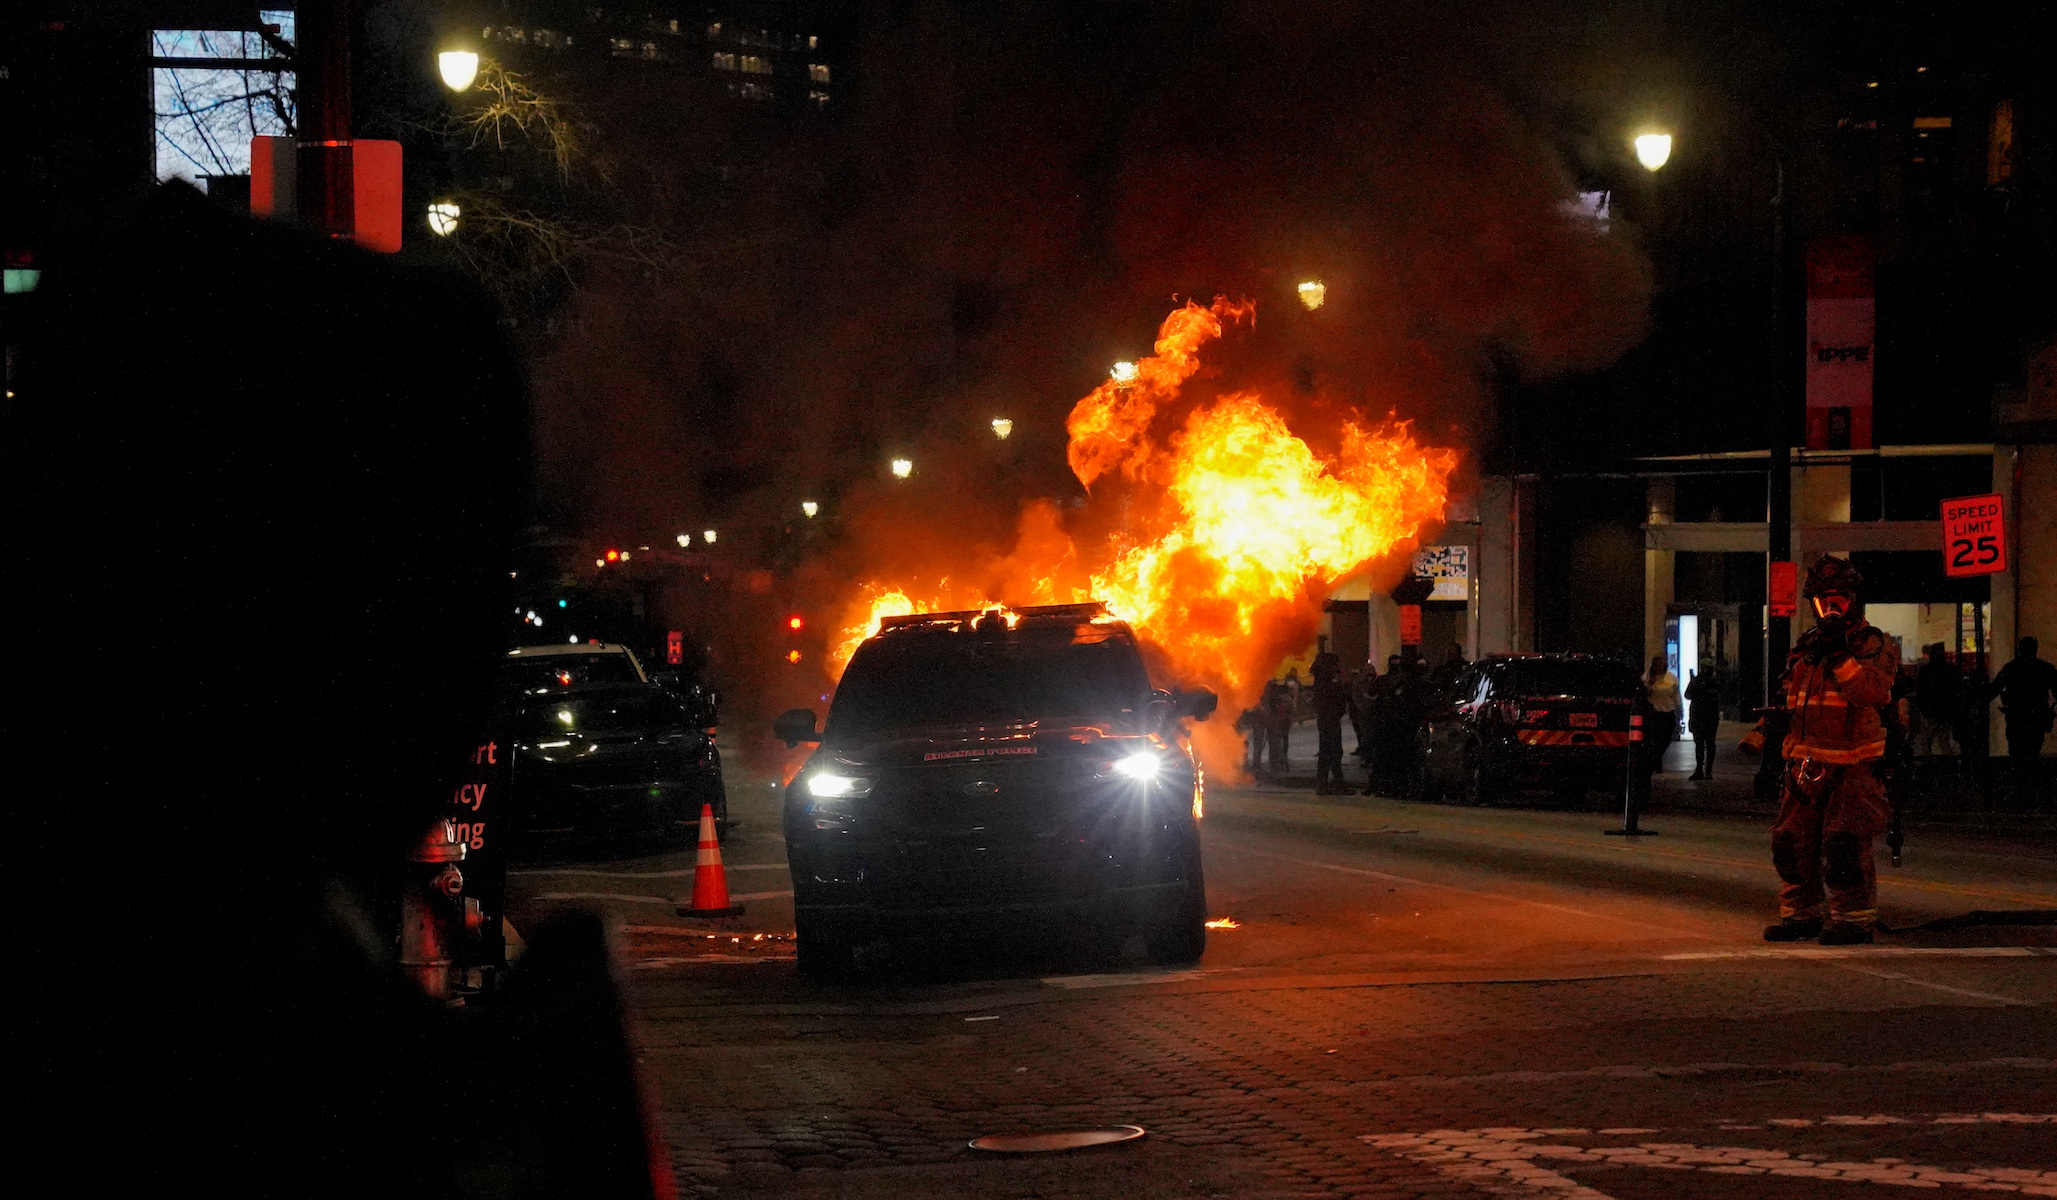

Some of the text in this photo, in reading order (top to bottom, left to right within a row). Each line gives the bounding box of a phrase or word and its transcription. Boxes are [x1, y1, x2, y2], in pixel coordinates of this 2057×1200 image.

[1947, 504, 1998, 520] SPEED
[1953, 520, 1992, 536] LIMIT
[1952, 536, 1999, 567] 25
[470, 741, 498, 765] rt
[987, 747, 1038, 755] POLICE
